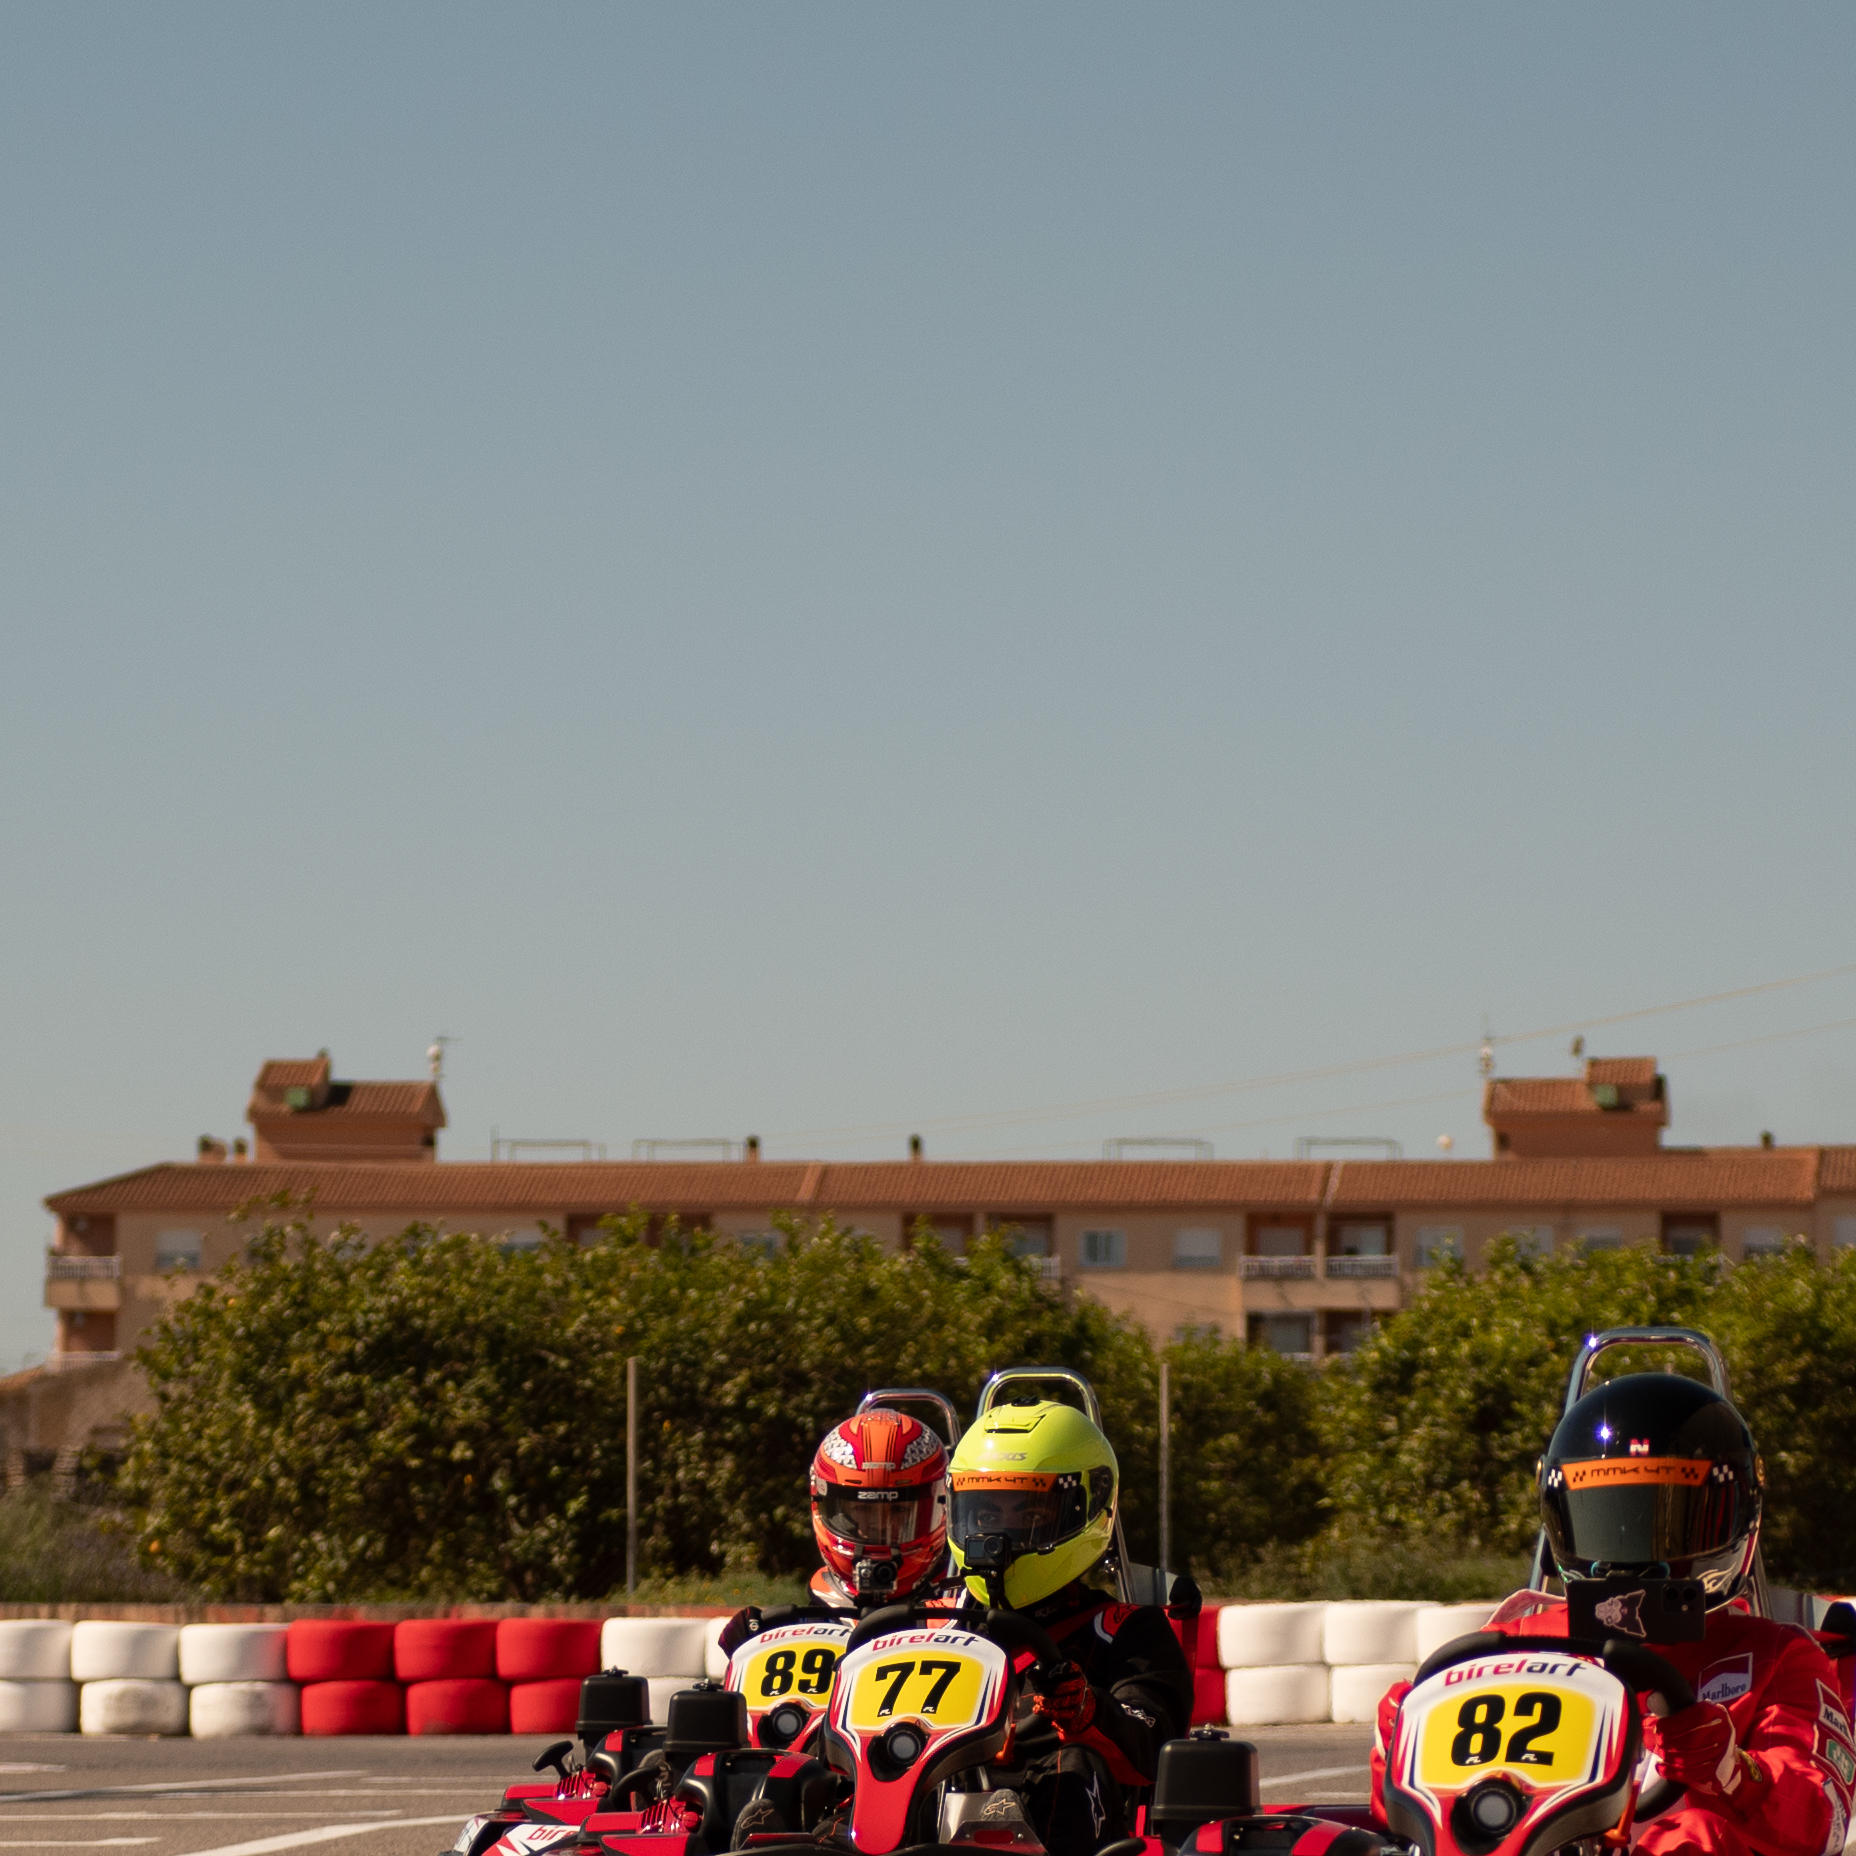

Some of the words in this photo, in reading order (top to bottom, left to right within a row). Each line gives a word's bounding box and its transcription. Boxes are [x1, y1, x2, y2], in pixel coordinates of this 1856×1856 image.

[857, 1491, 898, 1501] zamp
[759, 1626, 853, 1644] birelart
[872, 1632, 979, 1651] birelart
[760, 1648, 836, 1697] 89
[1444, 1659, 1588, 1687] birelart
[875, 1660, 962, 1718] 77
[1451, 1691, 1562, 1767] 82
